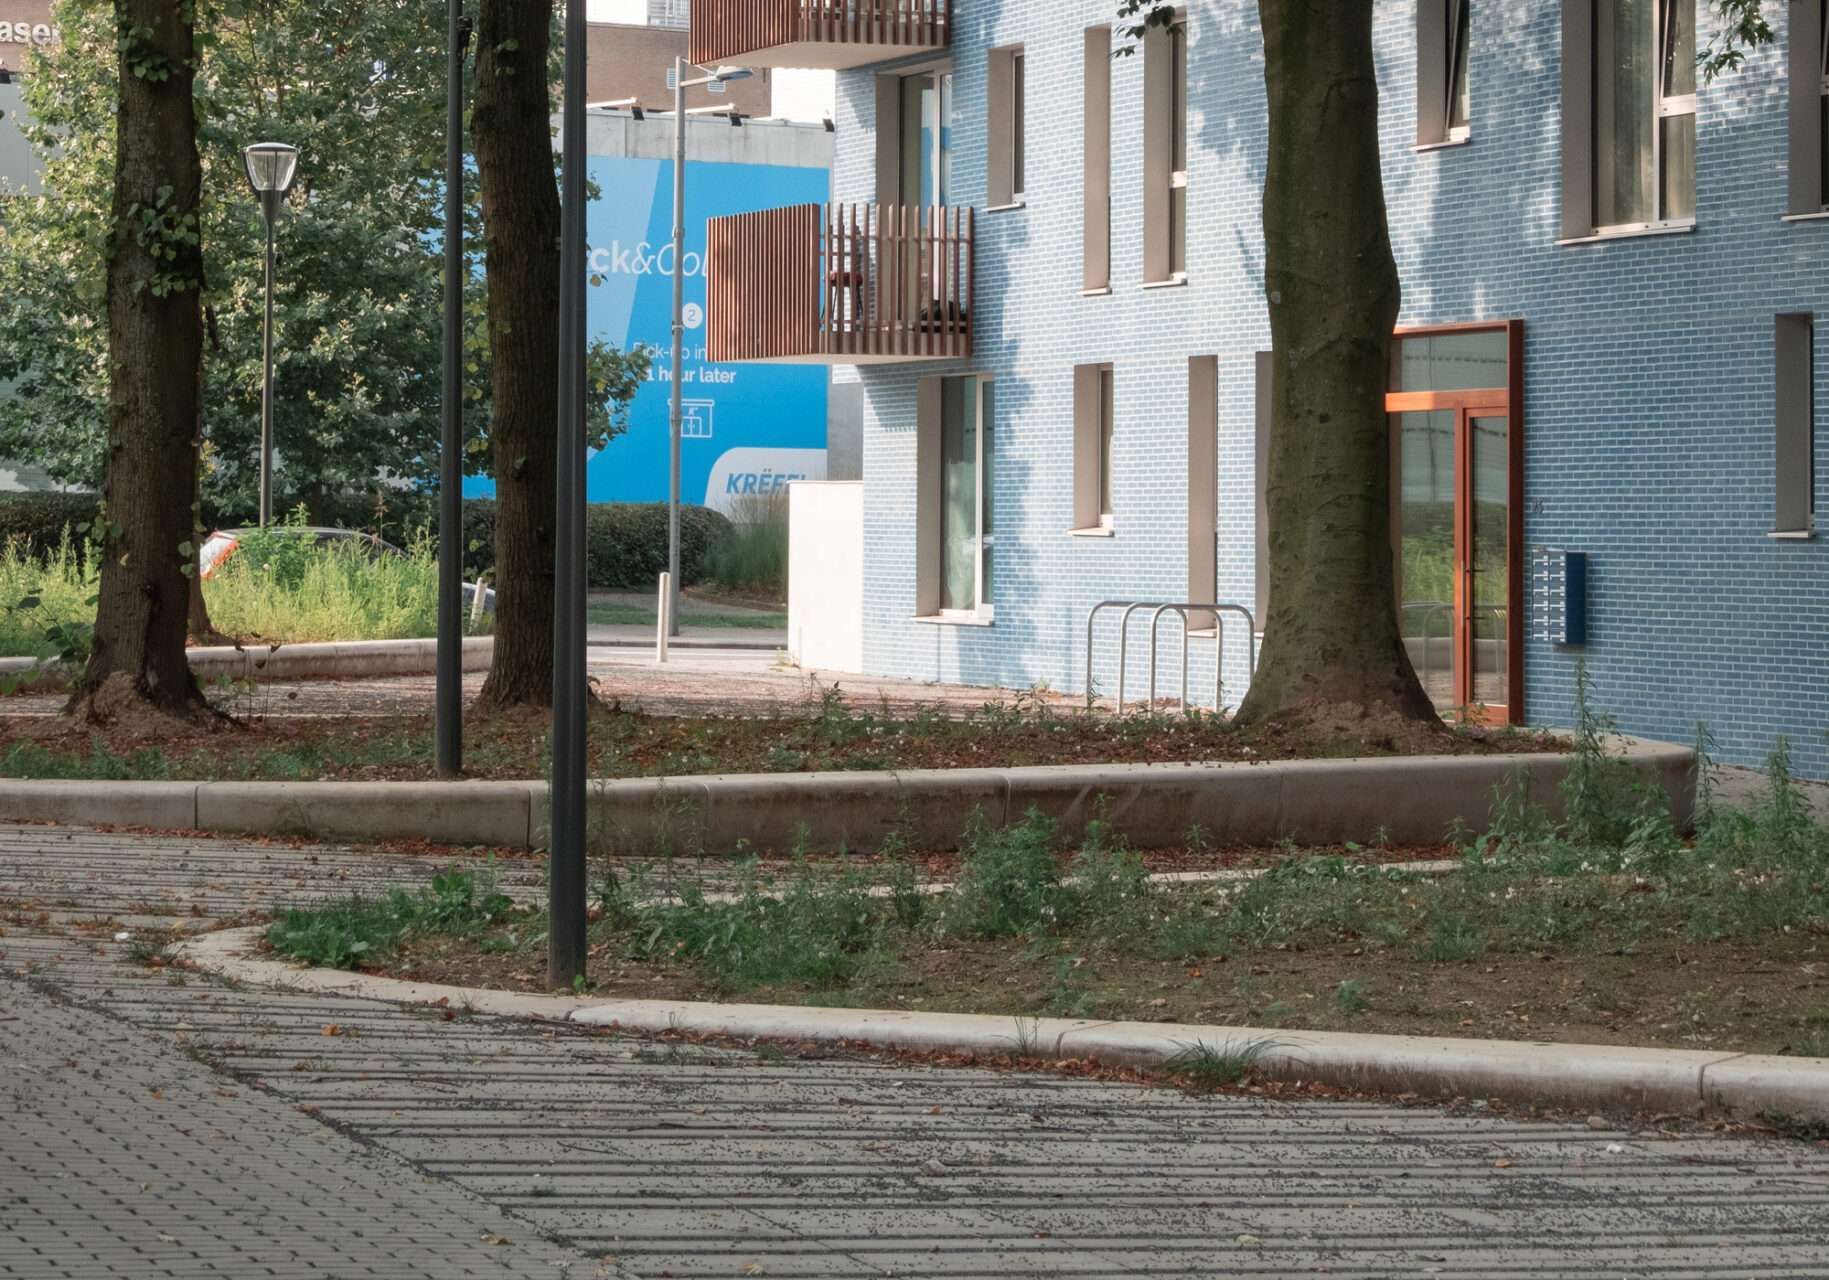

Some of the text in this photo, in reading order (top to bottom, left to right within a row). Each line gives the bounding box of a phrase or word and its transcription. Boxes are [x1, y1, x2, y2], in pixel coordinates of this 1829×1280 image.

[688, 309, 696, 322] 2
[633, 342, 690, 360] Pick-p
[700, 366, 737, 384] later
[726, 468, 806, 493] KRËF
